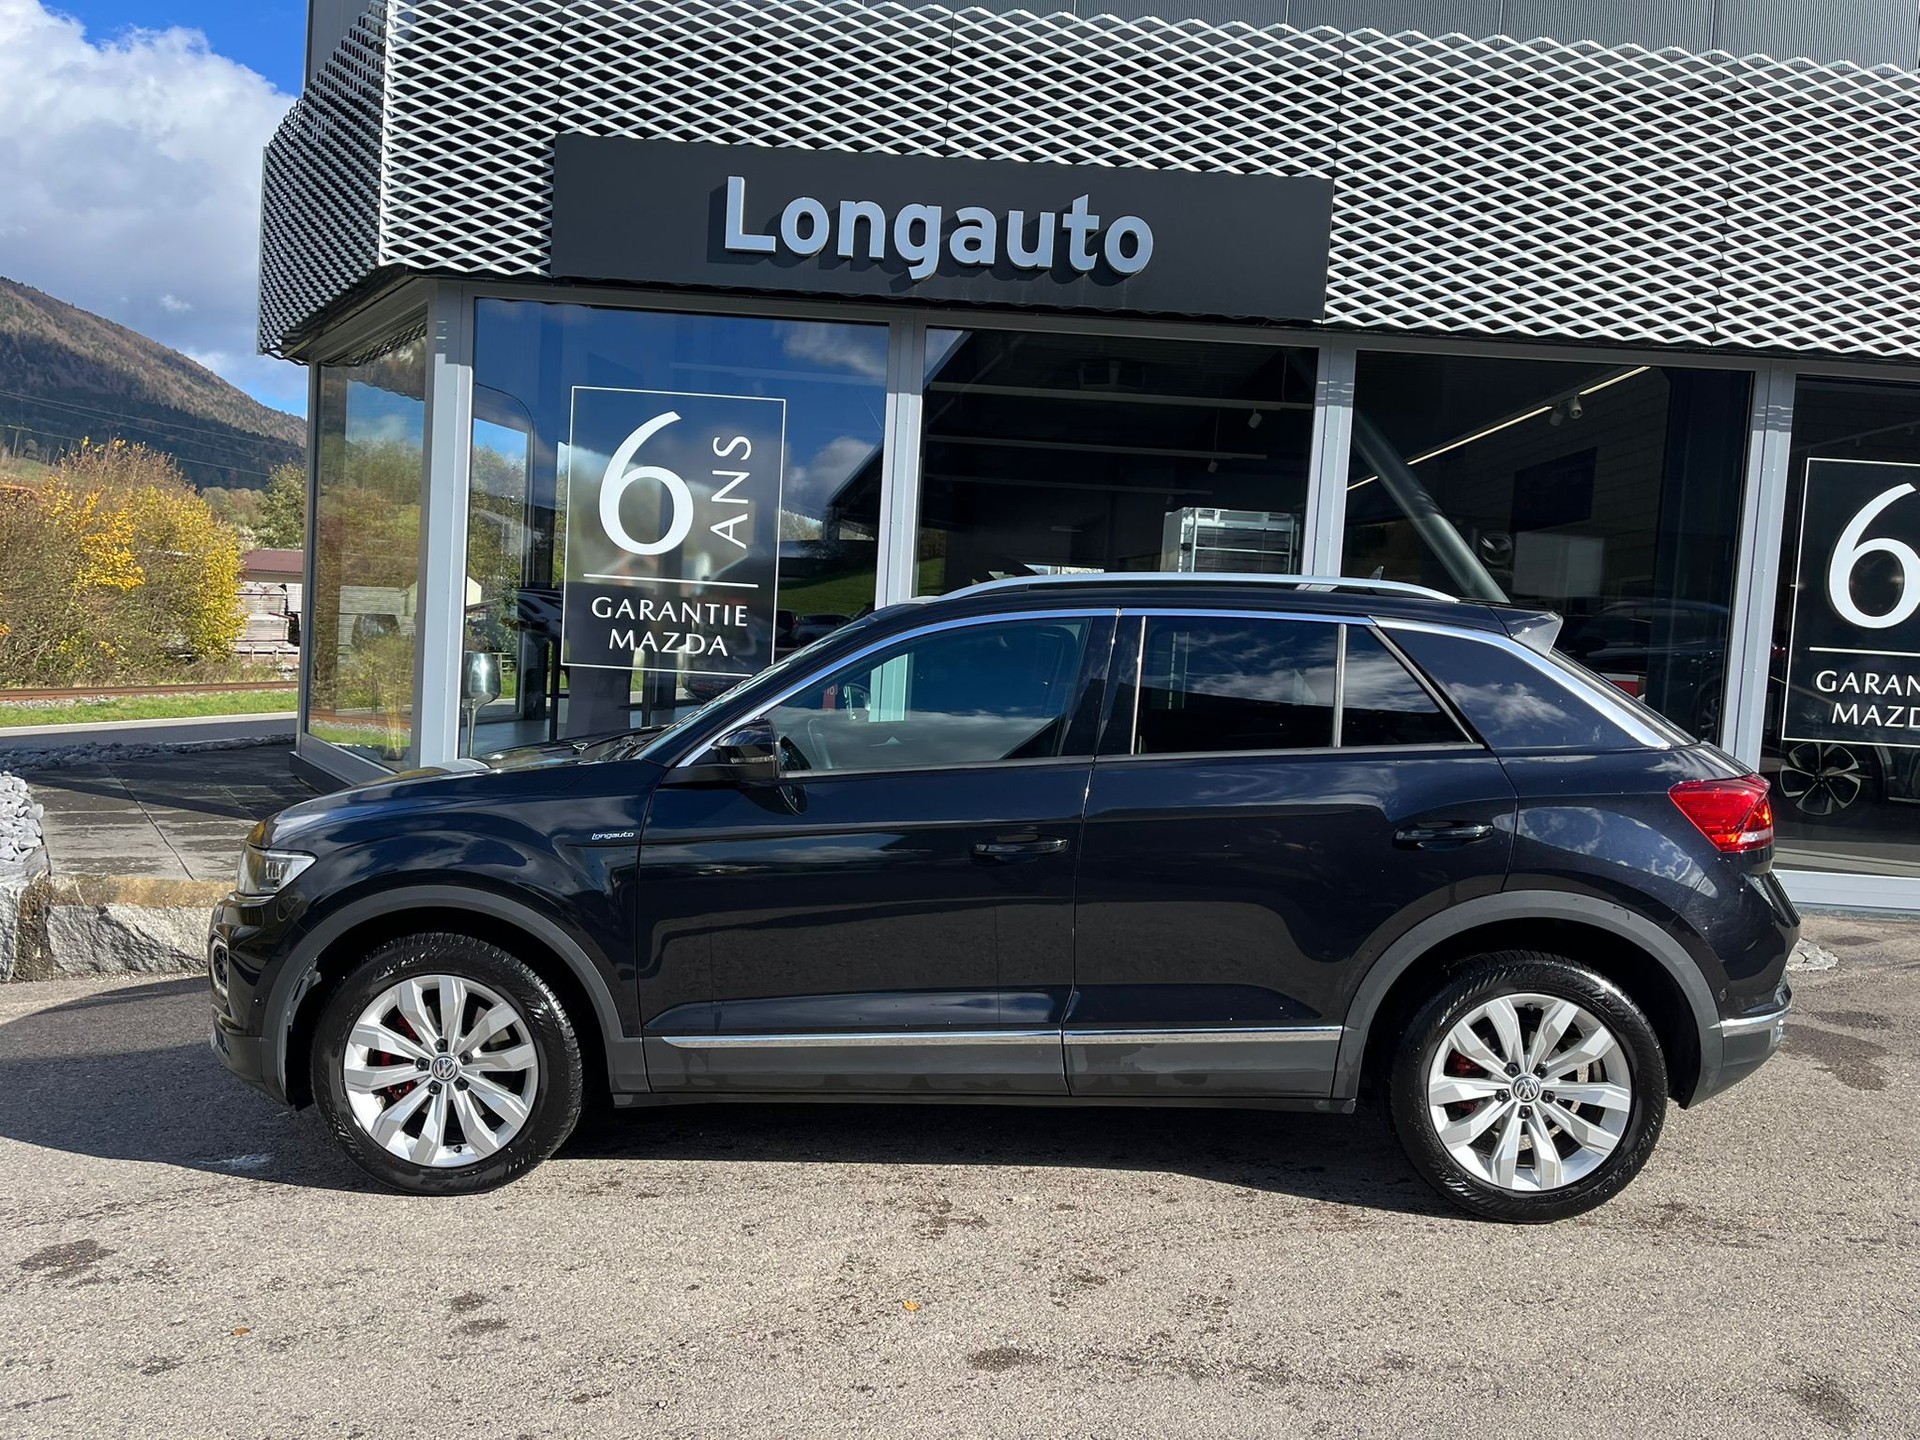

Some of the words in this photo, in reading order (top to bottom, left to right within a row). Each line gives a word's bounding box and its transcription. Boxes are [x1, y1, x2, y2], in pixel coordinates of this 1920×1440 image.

[724, 175, 1155, 282] Longauto
[599, 410, 694, 556] 6
[709, 435, 752, 550] ANS
[1828, 482, 1920, 629] 6
[591, 596, 749, 628] GARANTIE
[608, 628, 729, 657] MAZDA
